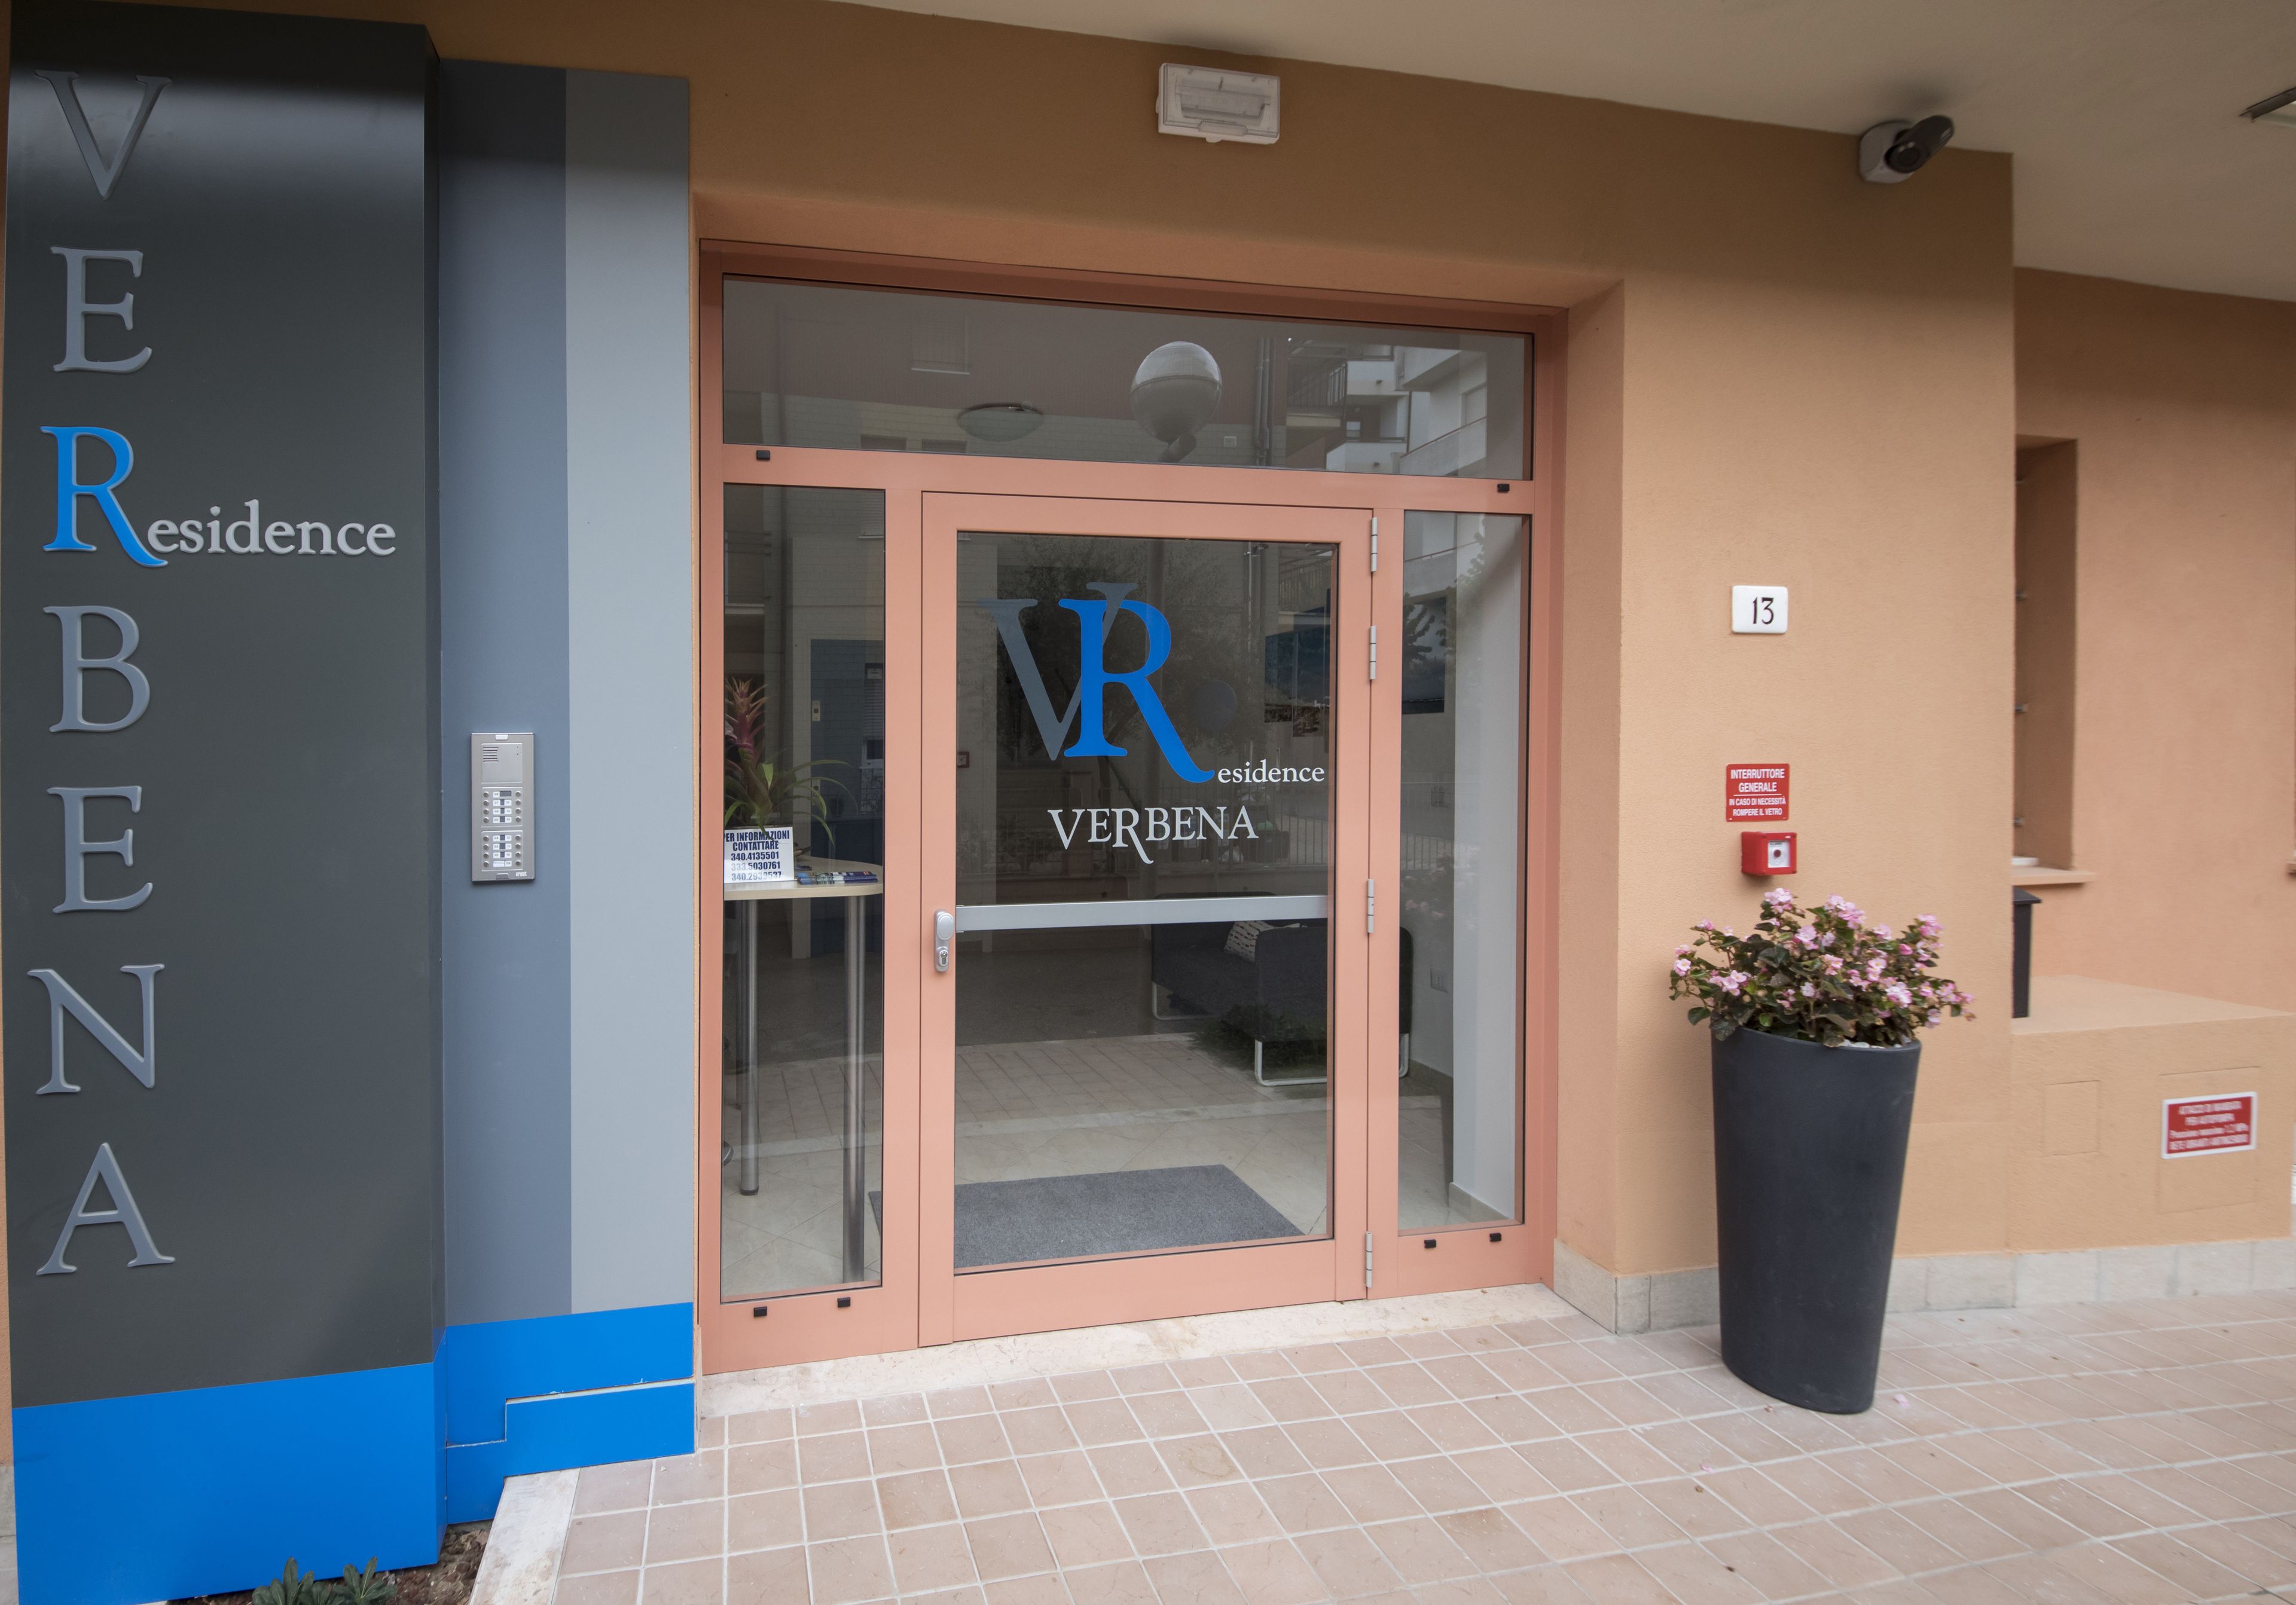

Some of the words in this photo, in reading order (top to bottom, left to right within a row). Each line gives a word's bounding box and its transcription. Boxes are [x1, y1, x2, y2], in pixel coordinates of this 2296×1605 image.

[1751, 596, 1775, 625] 13
[1731, 769, 1785, 779] INTERRUTTORE
[1738, 782, 1777, 793] GENERALE
[1758, 796, 1786, 805] NECESSITÀ
[737, 830, 789, 842] INFORMAZIONI
[1048, 805, 1258, 864] VERBENA
[732, 840, 779, 851] CONTATTARE
[731, 851, 779, 861] 340.4135501
[731, 861, 780, 871] 333.5030761
